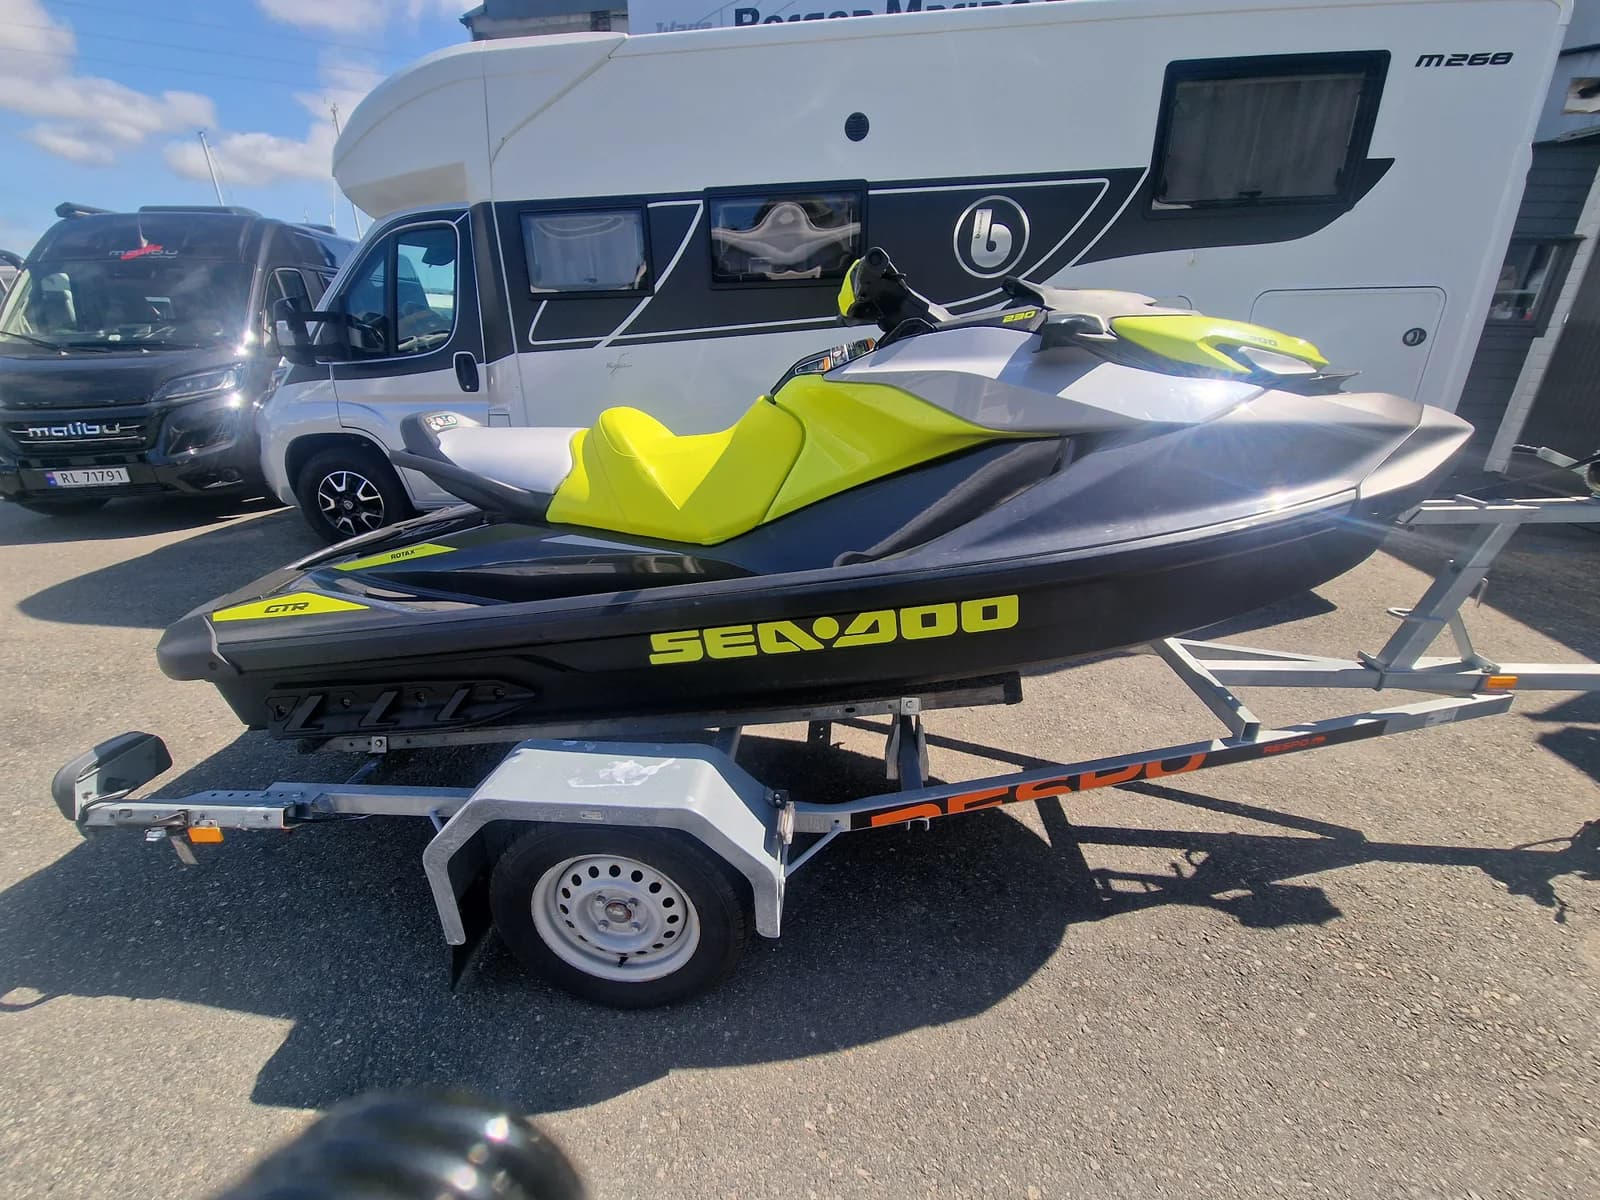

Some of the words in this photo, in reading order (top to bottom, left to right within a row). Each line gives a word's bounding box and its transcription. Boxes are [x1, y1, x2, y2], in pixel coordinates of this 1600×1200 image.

[28, 422, 120, 437] malibu
[60, 472, 79, 484] RL
[82, 470, 124, 483] 71791
[390, 549, 416, 560] ROTAX
[263, 602, 310, 614] GTR
